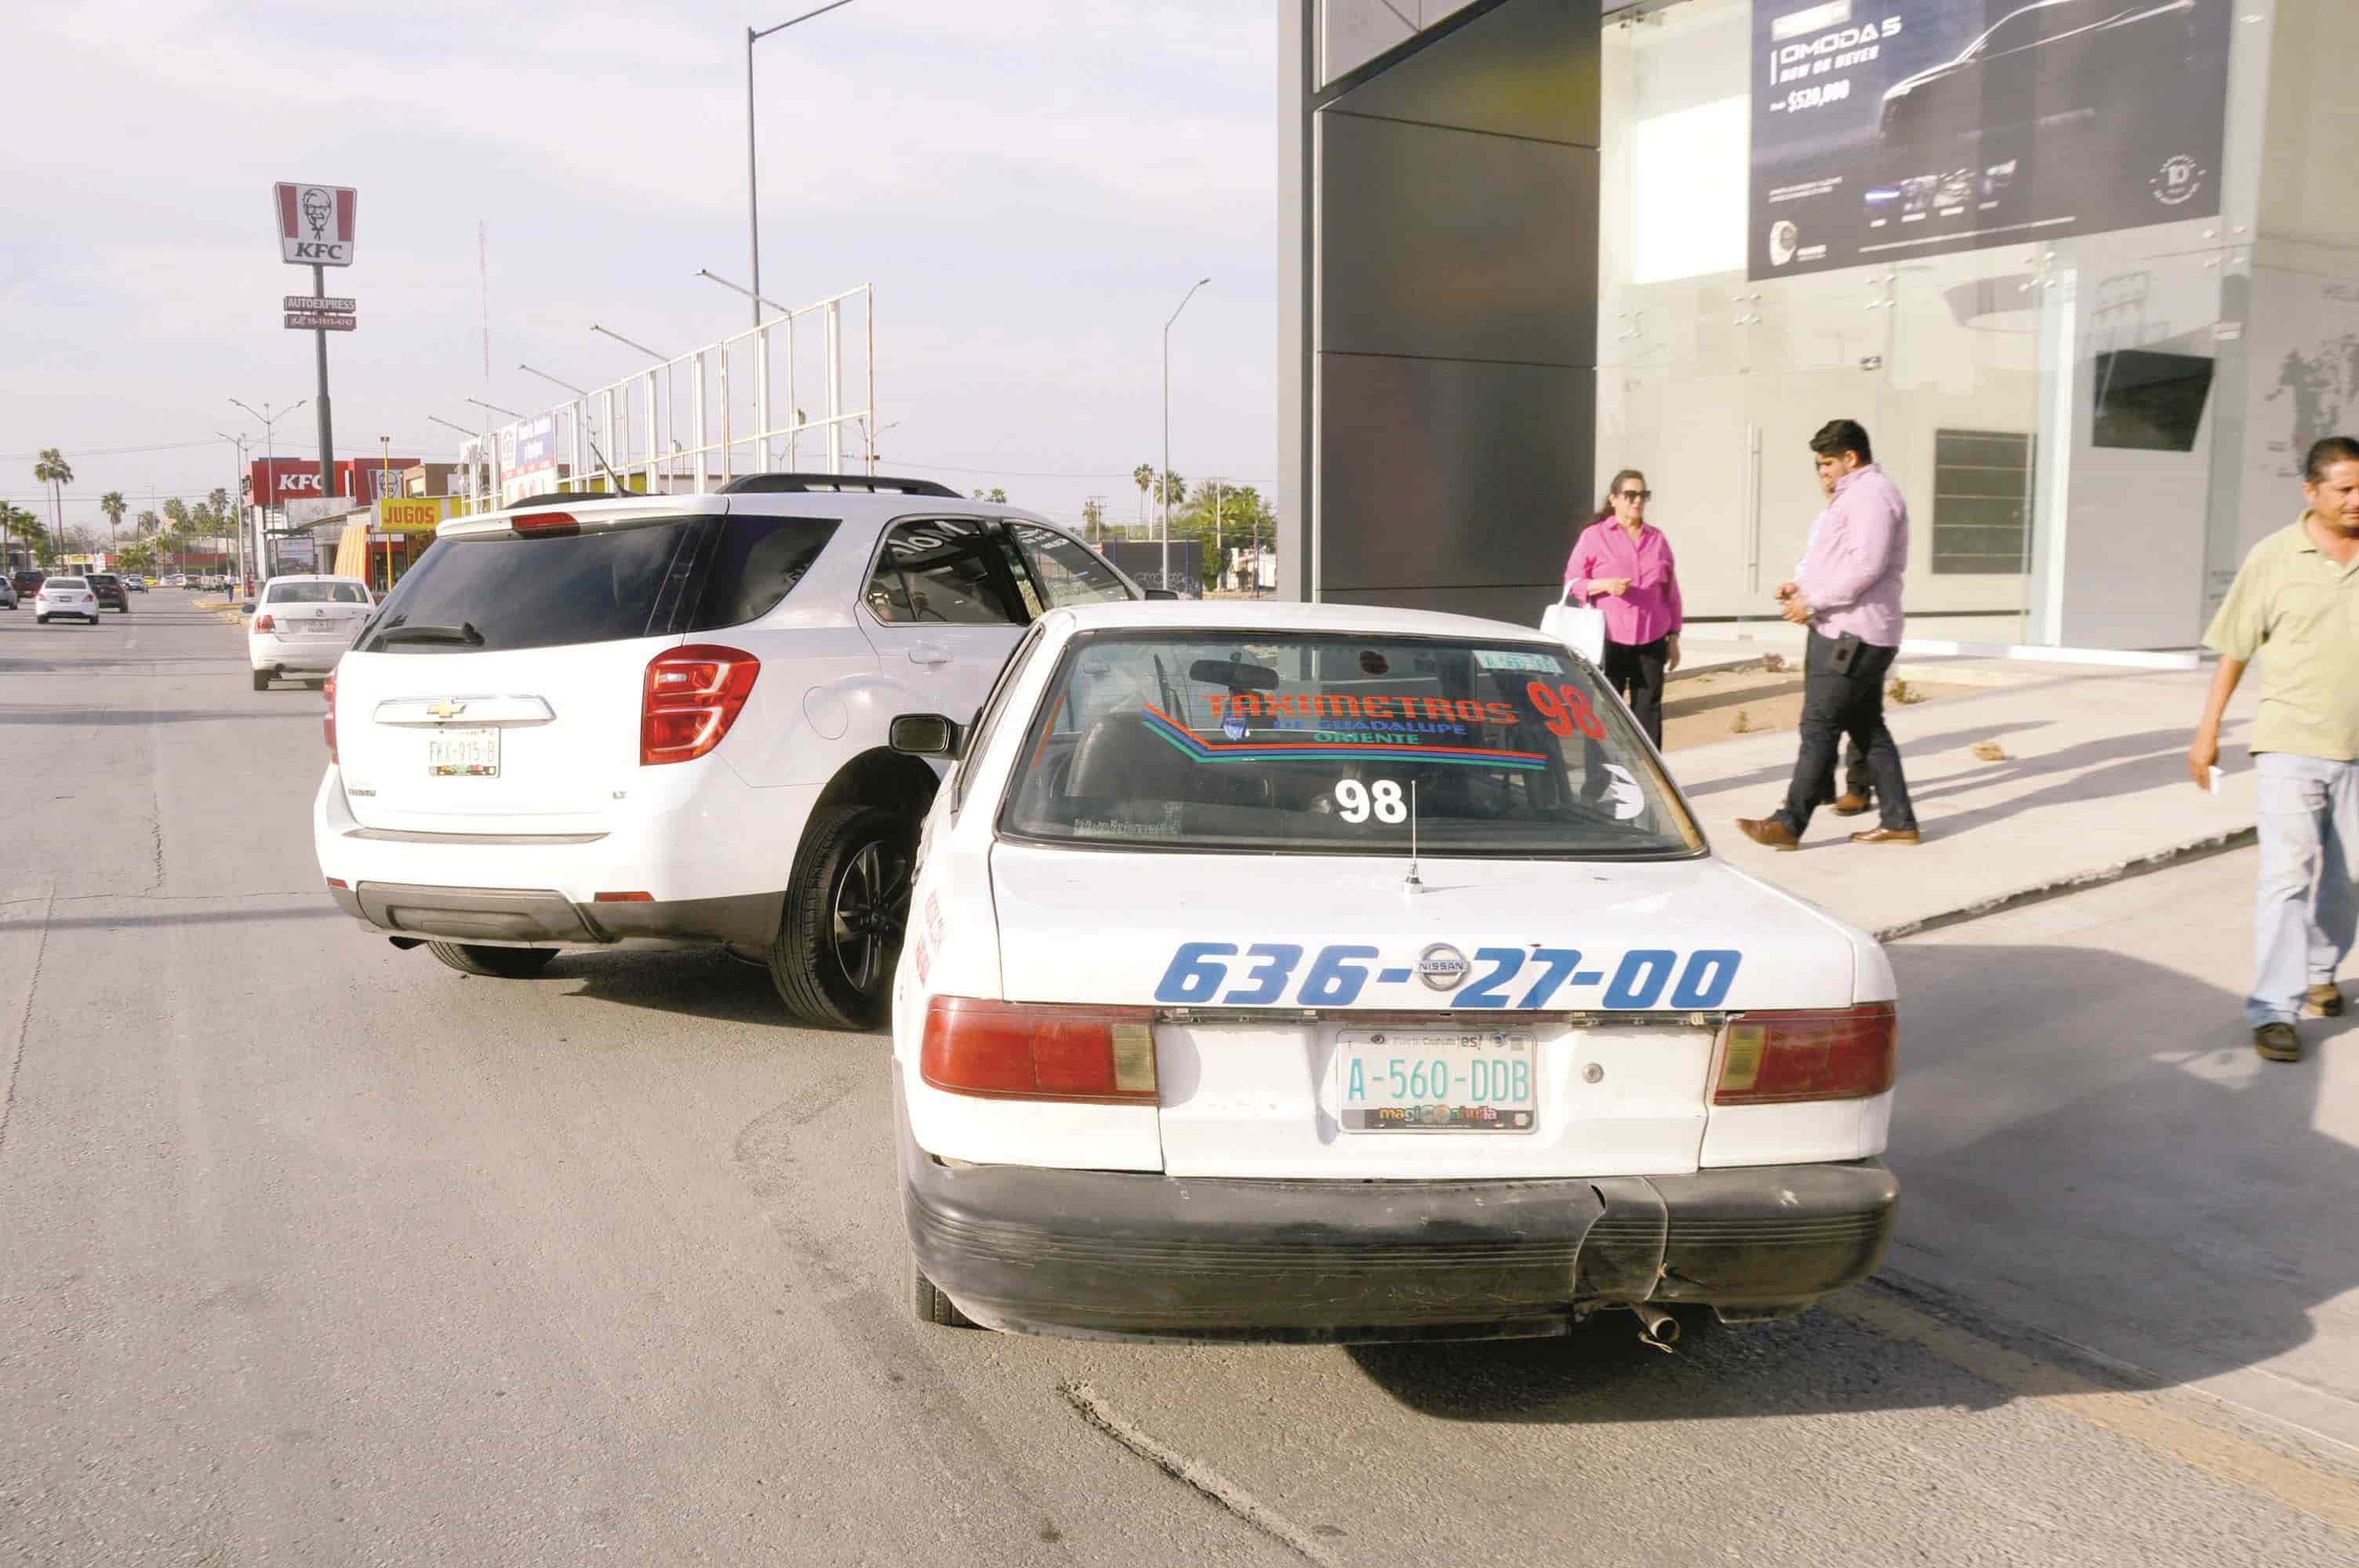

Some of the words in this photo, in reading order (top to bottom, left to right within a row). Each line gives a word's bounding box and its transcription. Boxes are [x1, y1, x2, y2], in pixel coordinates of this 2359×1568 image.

[1780, 23, 1879, 64] OMODA
[295, 241, 342, 260] KFC
[288, 297, 355, 310] AUTOEXPRESS
[383, 506, 435, 524] JUGOS
[1201, 694, 1517, 725] TAXIMETROS
[1526, 681, 1606, 740] 98
[1318, 720, 1468, 735] GUADALUPE
[1314, 732, 1419, 745] ORIENTE
[1334, 778, 1408, 824] 98
[1419, 962, 1464, 971] NISSAN
[1347, 1058, 1529, 1102] A-560-DDB
